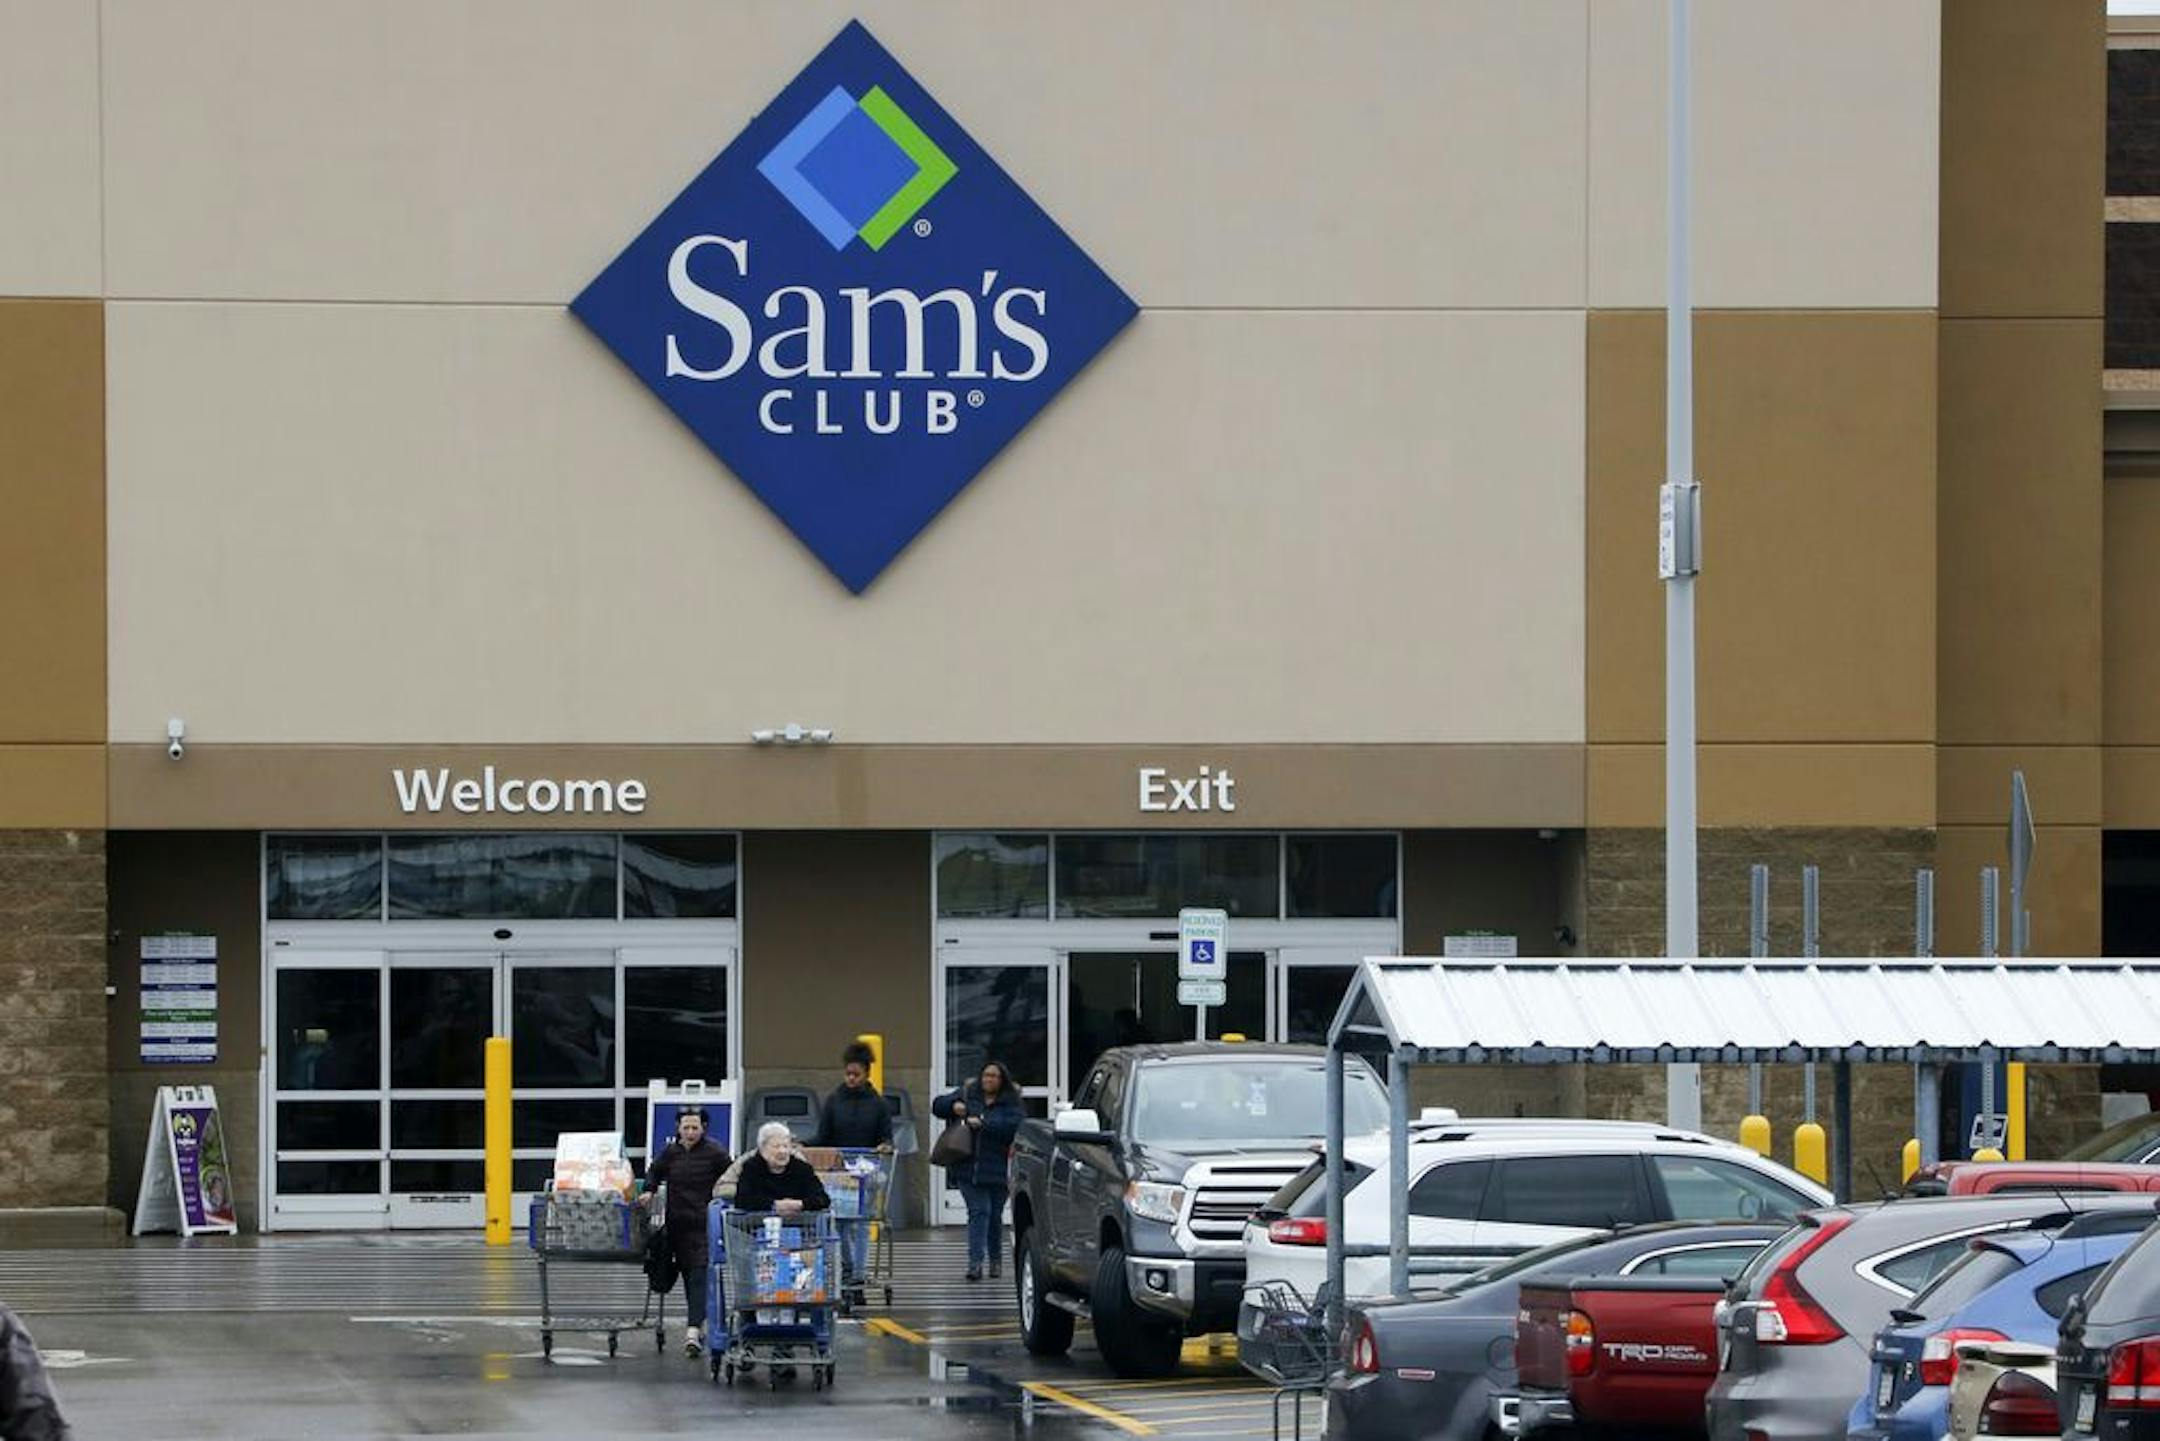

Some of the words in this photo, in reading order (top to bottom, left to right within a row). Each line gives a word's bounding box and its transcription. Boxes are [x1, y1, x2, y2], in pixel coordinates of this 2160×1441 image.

[666, 235, 1049, 380] Sam's
[392, 766, 648, 813] Welcome
[1139, 765, 1235, 811] Exit
[1602, 1342, 1663, 1361] TRD
